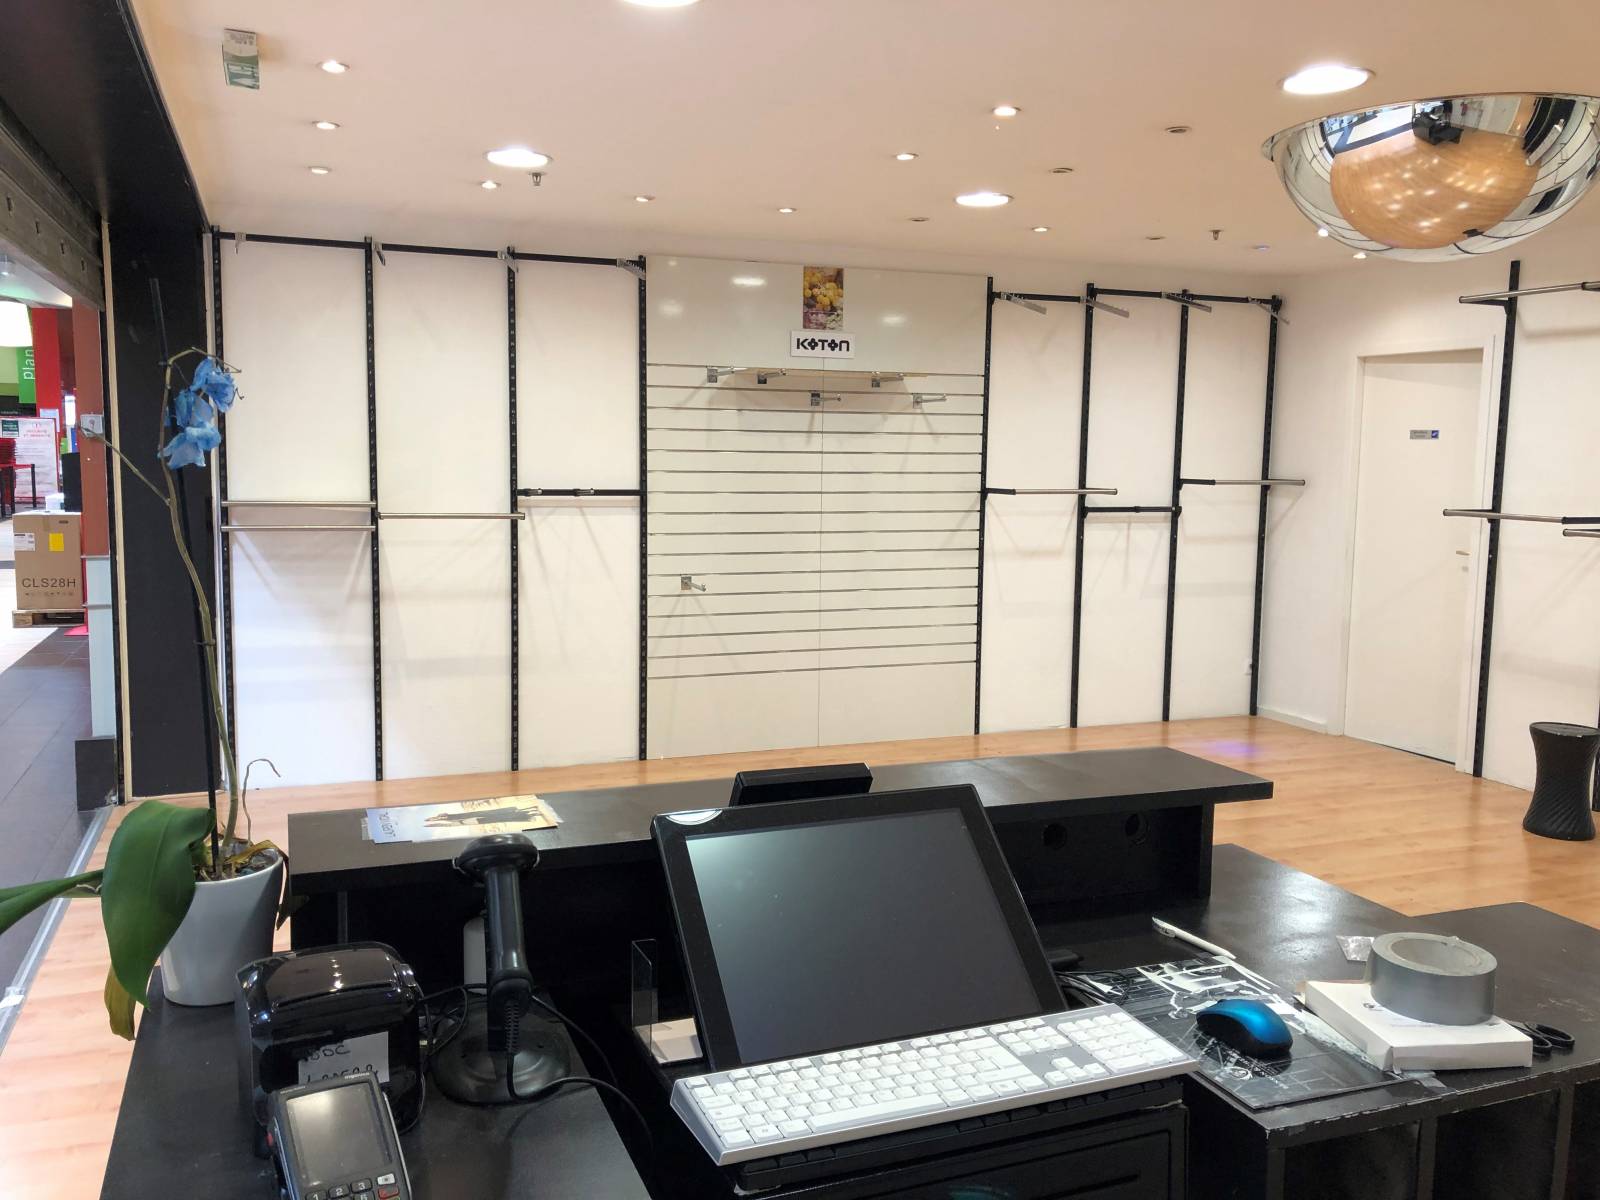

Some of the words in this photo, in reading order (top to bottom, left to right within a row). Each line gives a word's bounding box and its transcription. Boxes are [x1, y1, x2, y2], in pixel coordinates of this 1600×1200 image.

[22, 577, 76, 588] CLS28H
[335, 1187, 343, 1196] 2
[358, 1182, 366, 1190] 3
